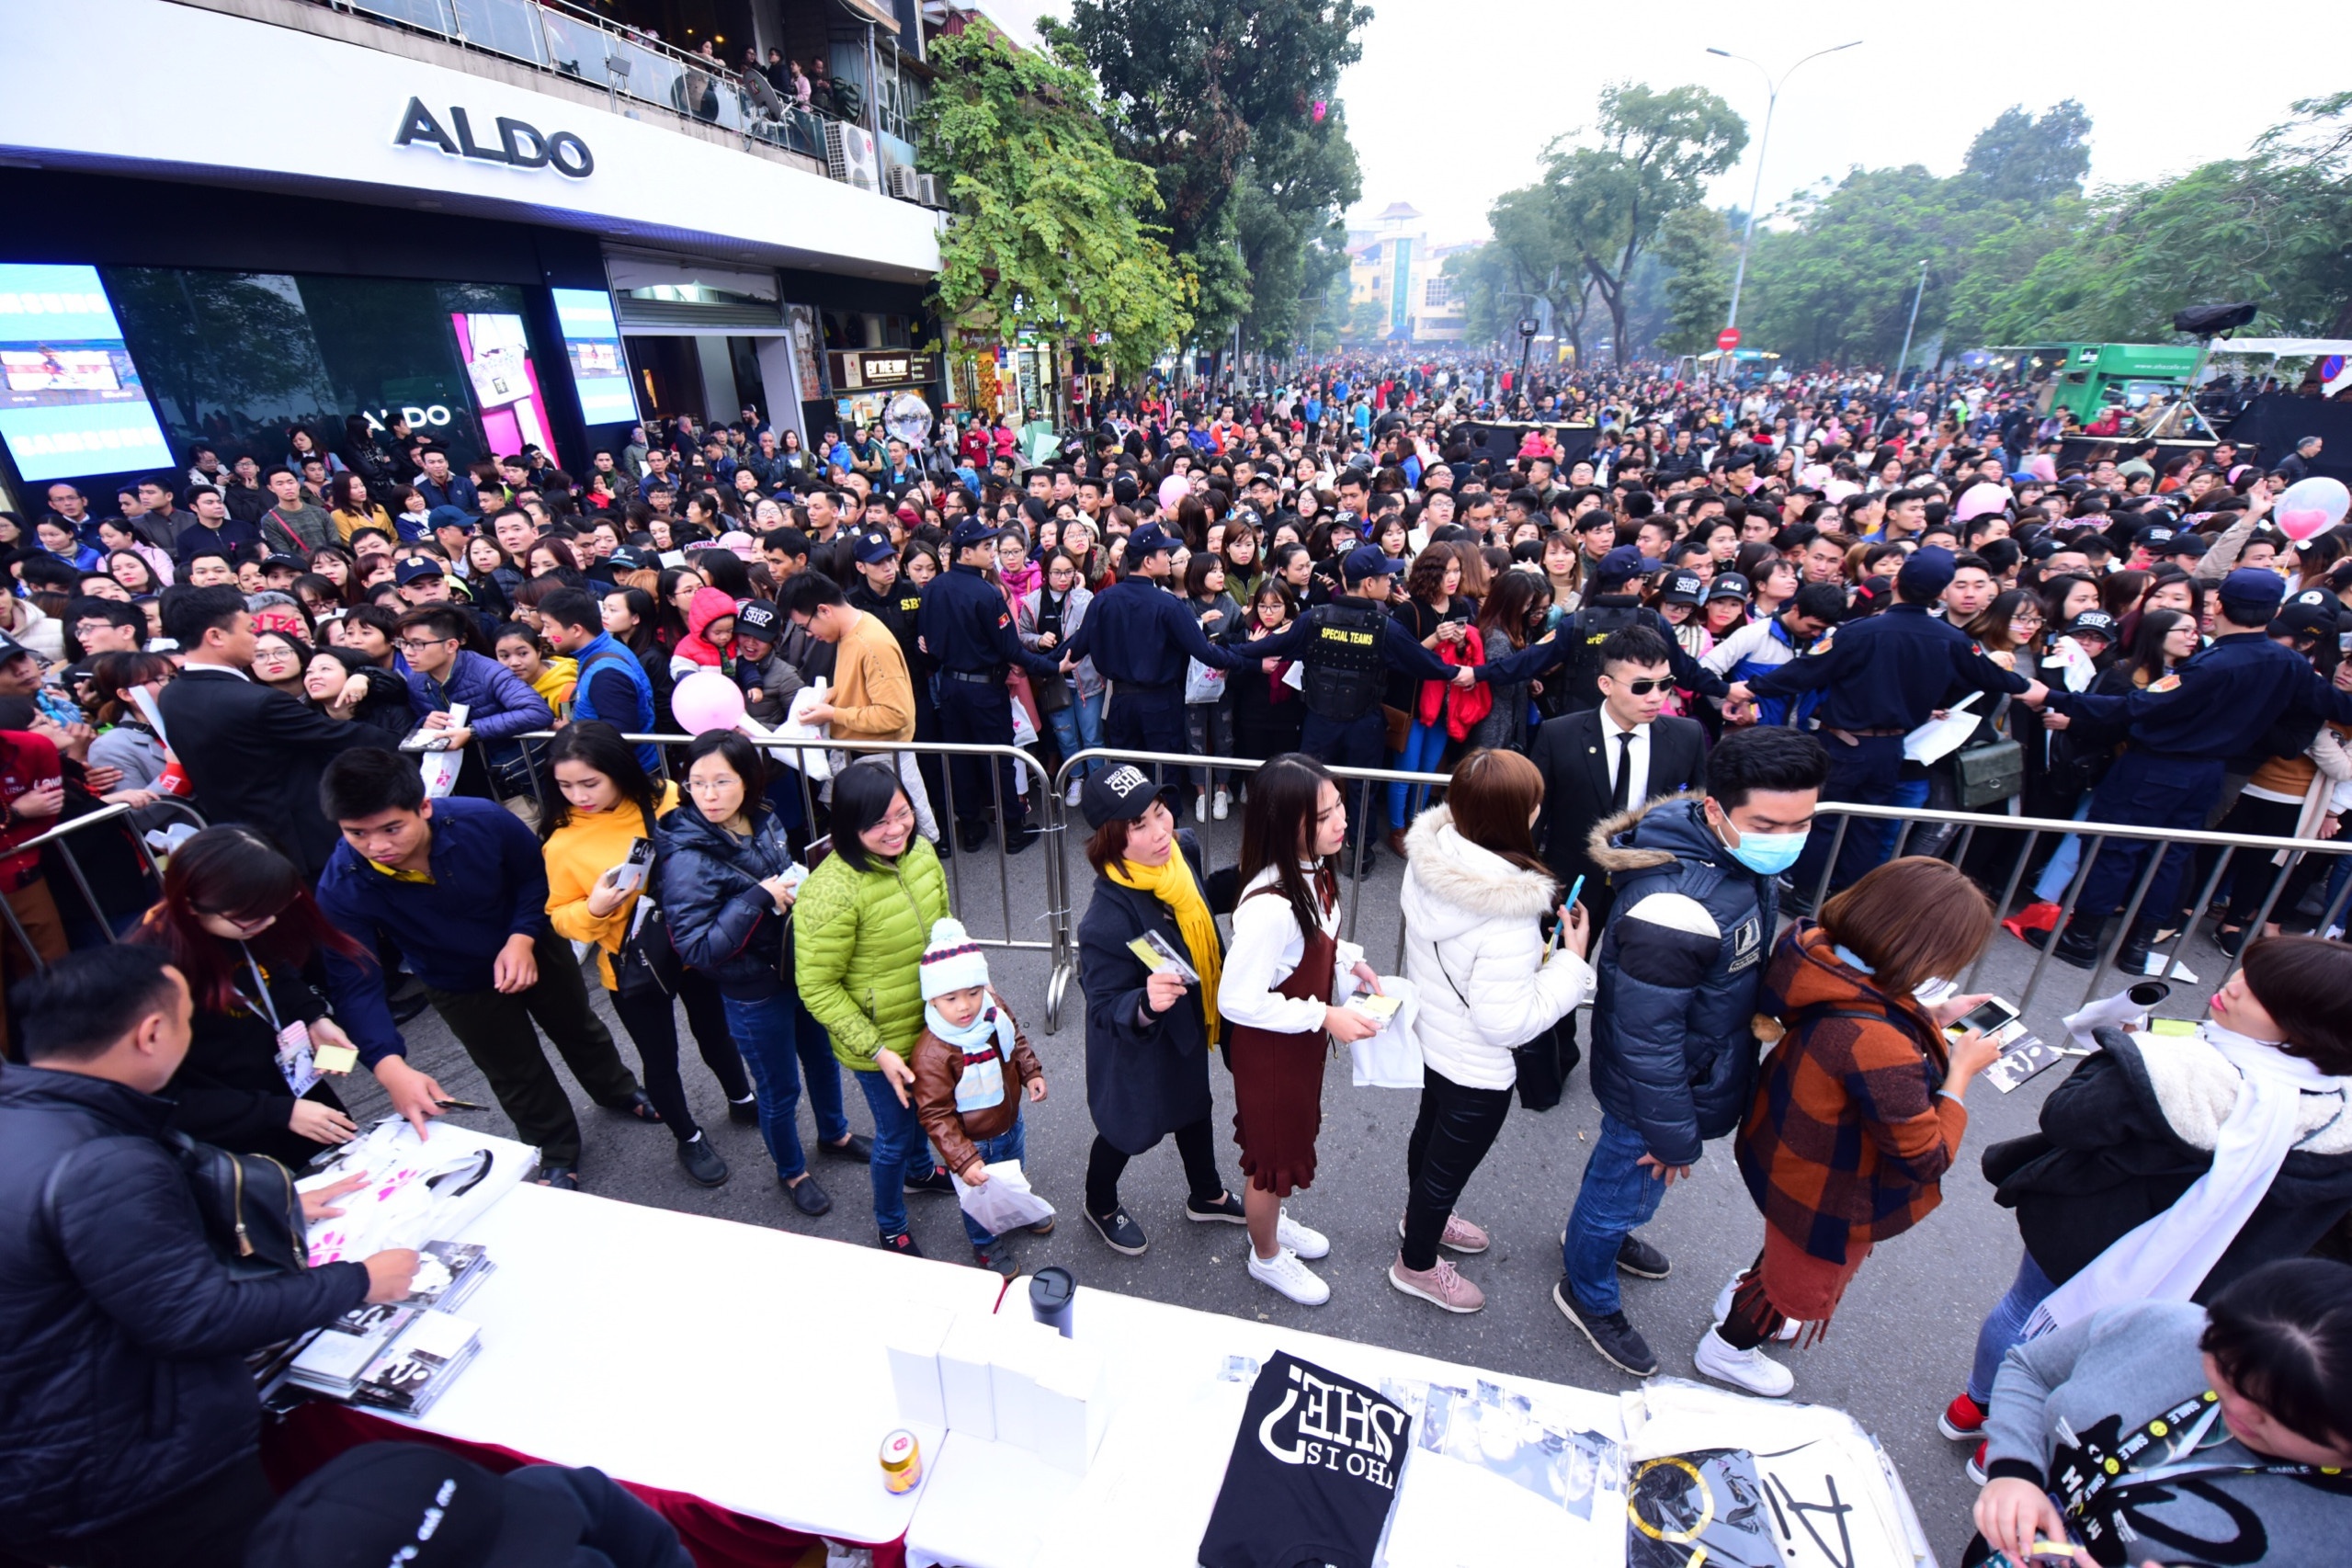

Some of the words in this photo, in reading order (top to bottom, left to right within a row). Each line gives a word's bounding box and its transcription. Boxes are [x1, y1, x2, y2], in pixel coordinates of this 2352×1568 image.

[392, 95, 596, 179] ALDO
[362, 404, 451, 431] ADO
[900, 597, 921, 610] SB
[743, 609, 774, 628] SHE?
[1321, 627, 1348, 642] SPECIAL
[1349, 631, 1374, 646] TEAMS
[1104, 769, 1121, 785] WHO
[2165, 1400, 2201, 1425] SMILE
[1306, 1442, 1341, 1471] IS
[2117, 1432, 2149, 1460] SMILE
[2084, 1472, 2107, 1501] SMILE
